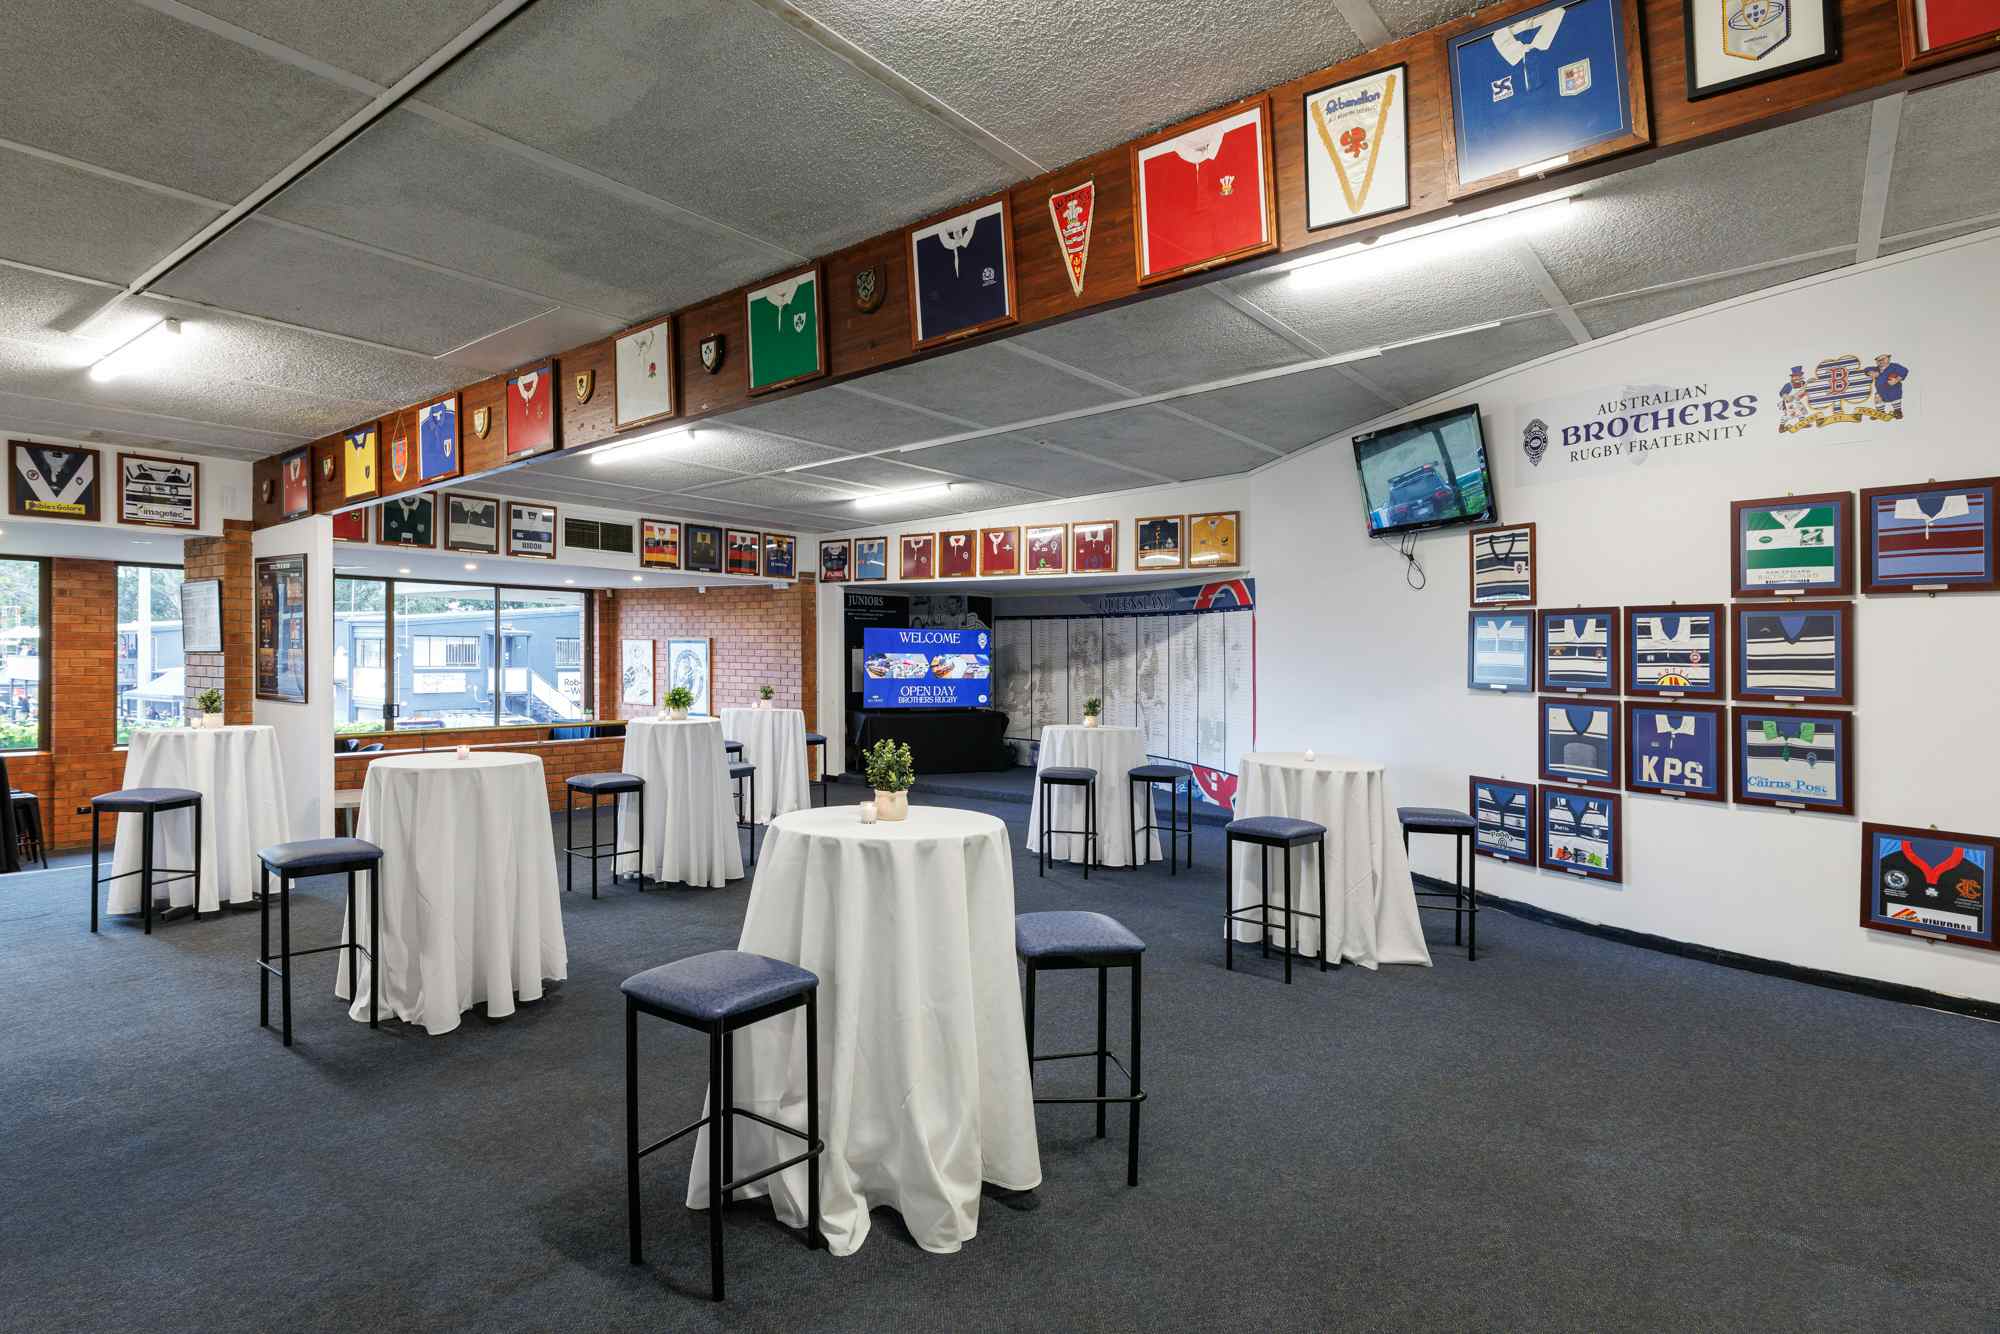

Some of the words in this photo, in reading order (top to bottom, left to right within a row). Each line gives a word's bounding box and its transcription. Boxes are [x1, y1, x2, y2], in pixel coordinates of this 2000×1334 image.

[1830, 367, 1849, 395] B
[1597, 383, 1709, 416] AUSTRALIAN
[1562, 394, 1759, 447] BROTHERS
[1569, 441, 1625, 463] RUGBY
[1628, 423, 1749, 454] FRATERNITY
[847, 595, 884, 607] JUNIORS
[899, 631, 961, 644] WELCOME
[898, 696, 933, 704] BROTHERS
[934, 696, 958, 704] RUGBY
[900, 686, 931, 696] OPEN
[933, 686, 956, 696] DAY
[1642, 755, 1703, 787] KPS
[1748, 775, 1792, 789] Cairns
[1796, 779, 1828, 794] Post
